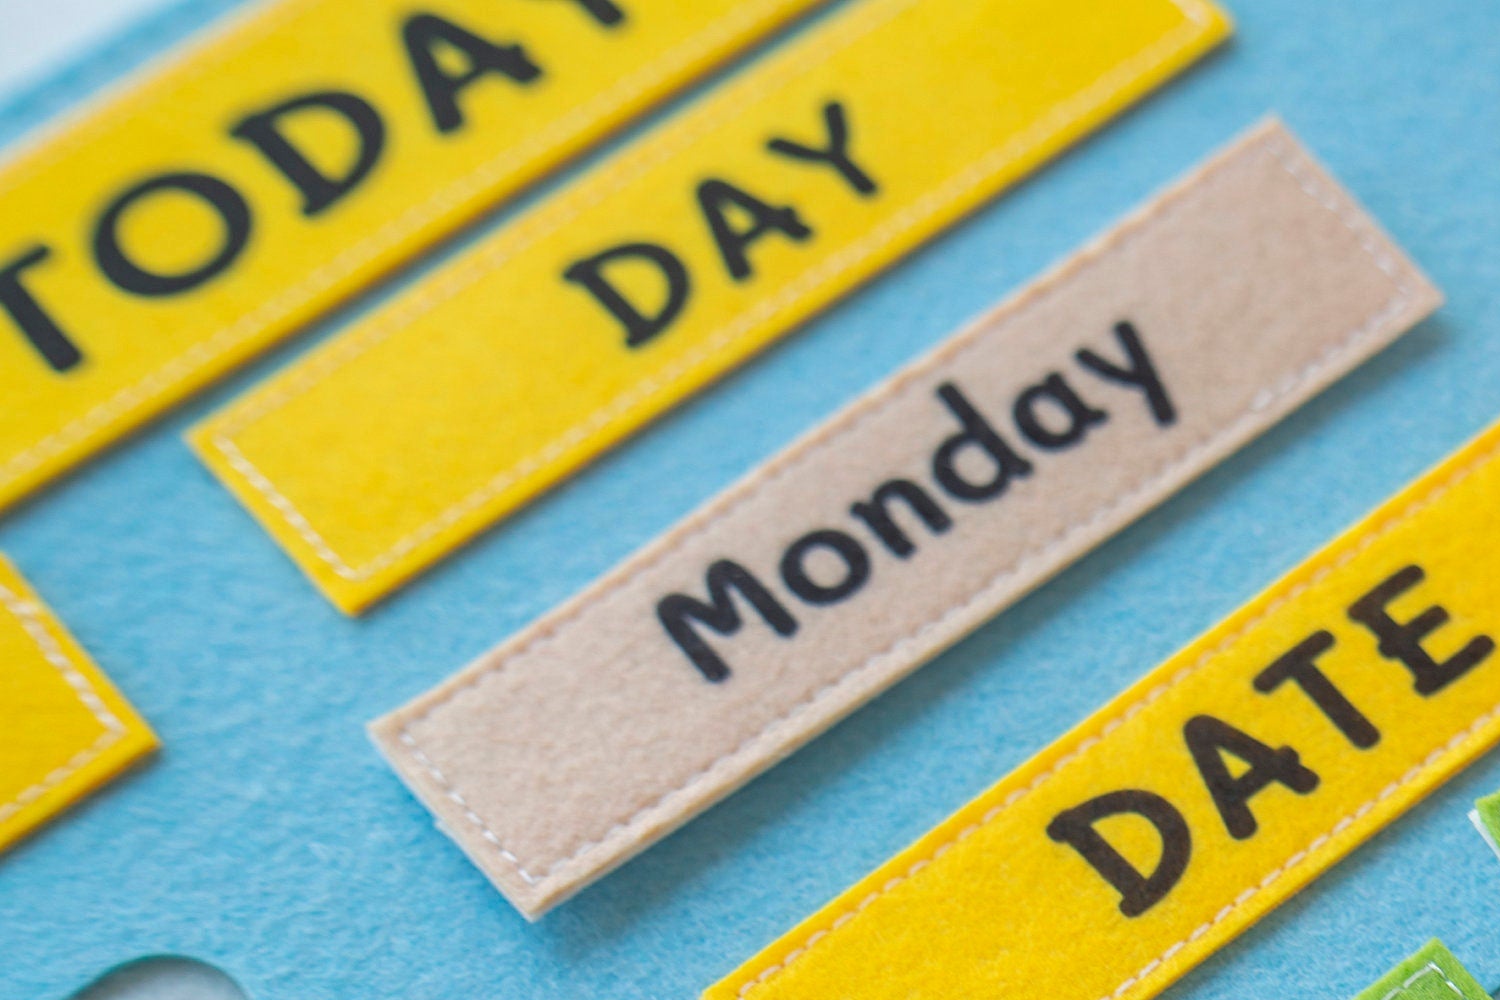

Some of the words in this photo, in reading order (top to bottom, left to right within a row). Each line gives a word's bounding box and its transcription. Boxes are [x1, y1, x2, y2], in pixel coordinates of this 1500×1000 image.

[0, 0, 628, 374] TODA
[561, 101, 879, 349] DAY
[655, 319, 1178, 683] Monday
[1045, 563, 1495, 918] DATE
